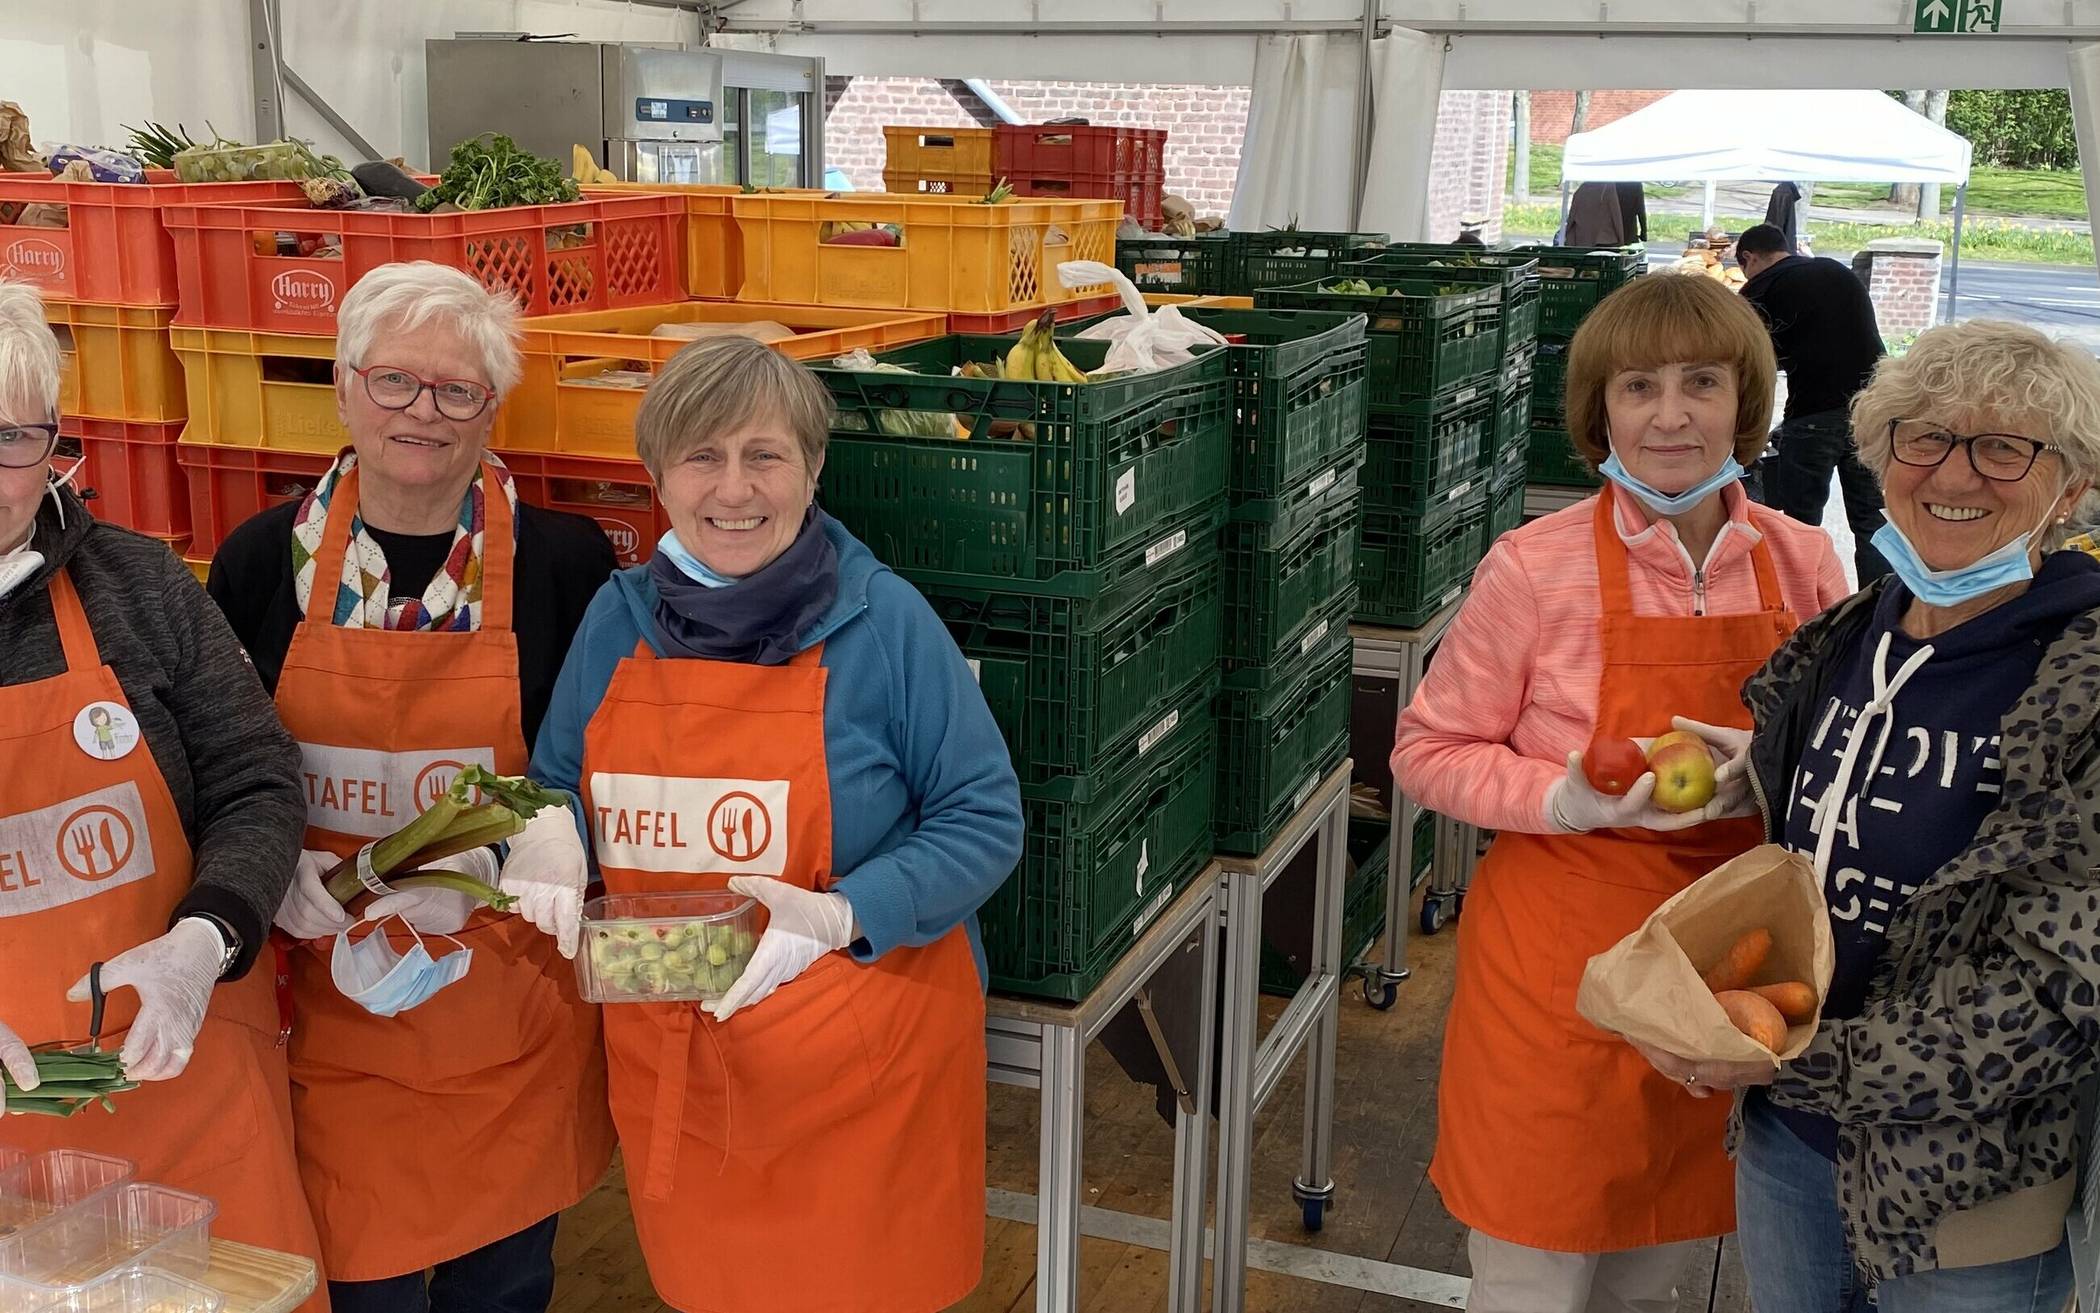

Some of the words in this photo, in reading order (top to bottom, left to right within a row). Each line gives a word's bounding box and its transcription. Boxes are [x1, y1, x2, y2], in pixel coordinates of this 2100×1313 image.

[13, 243, 59, 272] Harry
[278, 274, 329, 304] Harry
[303, 772, 395, 816] TAFEL
[598, 806, 687, 848] TAFEL
